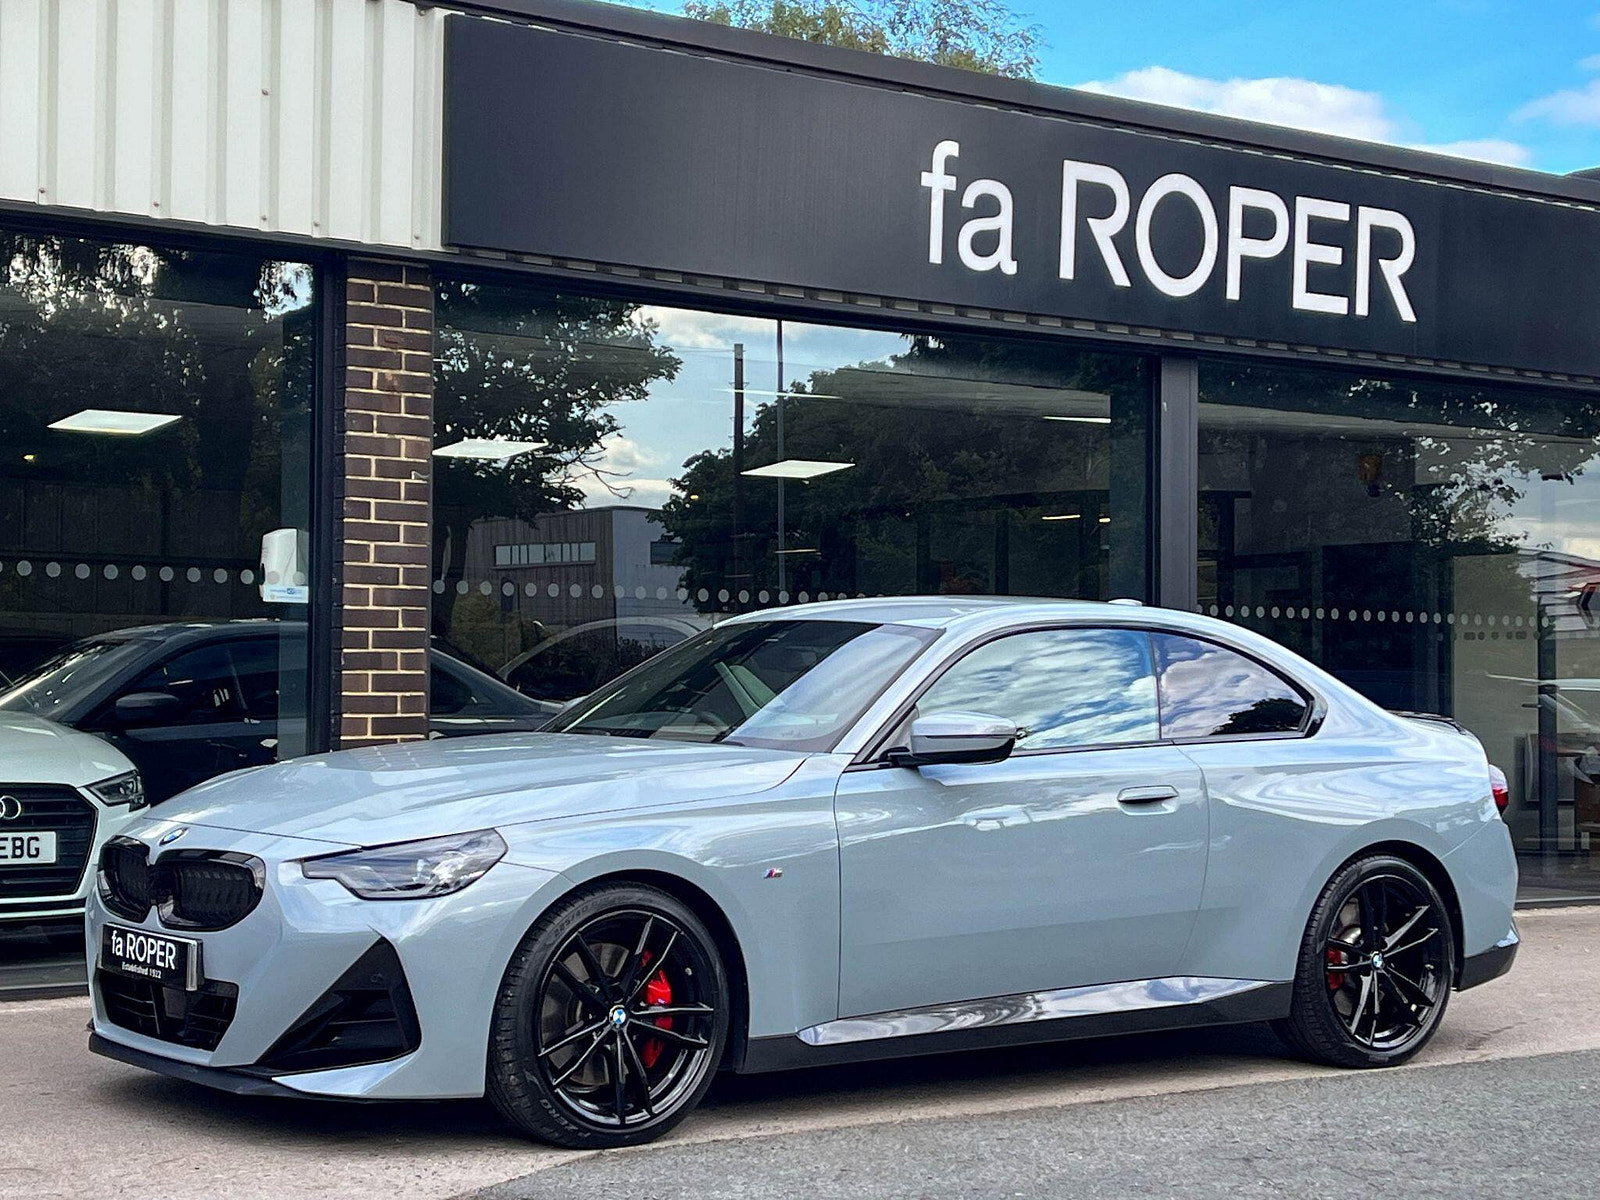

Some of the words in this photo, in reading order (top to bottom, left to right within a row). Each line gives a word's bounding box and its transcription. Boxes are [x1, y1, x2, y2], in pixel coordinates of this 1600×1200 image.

[920, 140, 1017, 275] fa
[1059, 160, 1417, 322] ROPER
[0, 836, 40, 859] EBG
[112, 930, 123, 957] fa
[126, 933, 176, 970] ROPER
